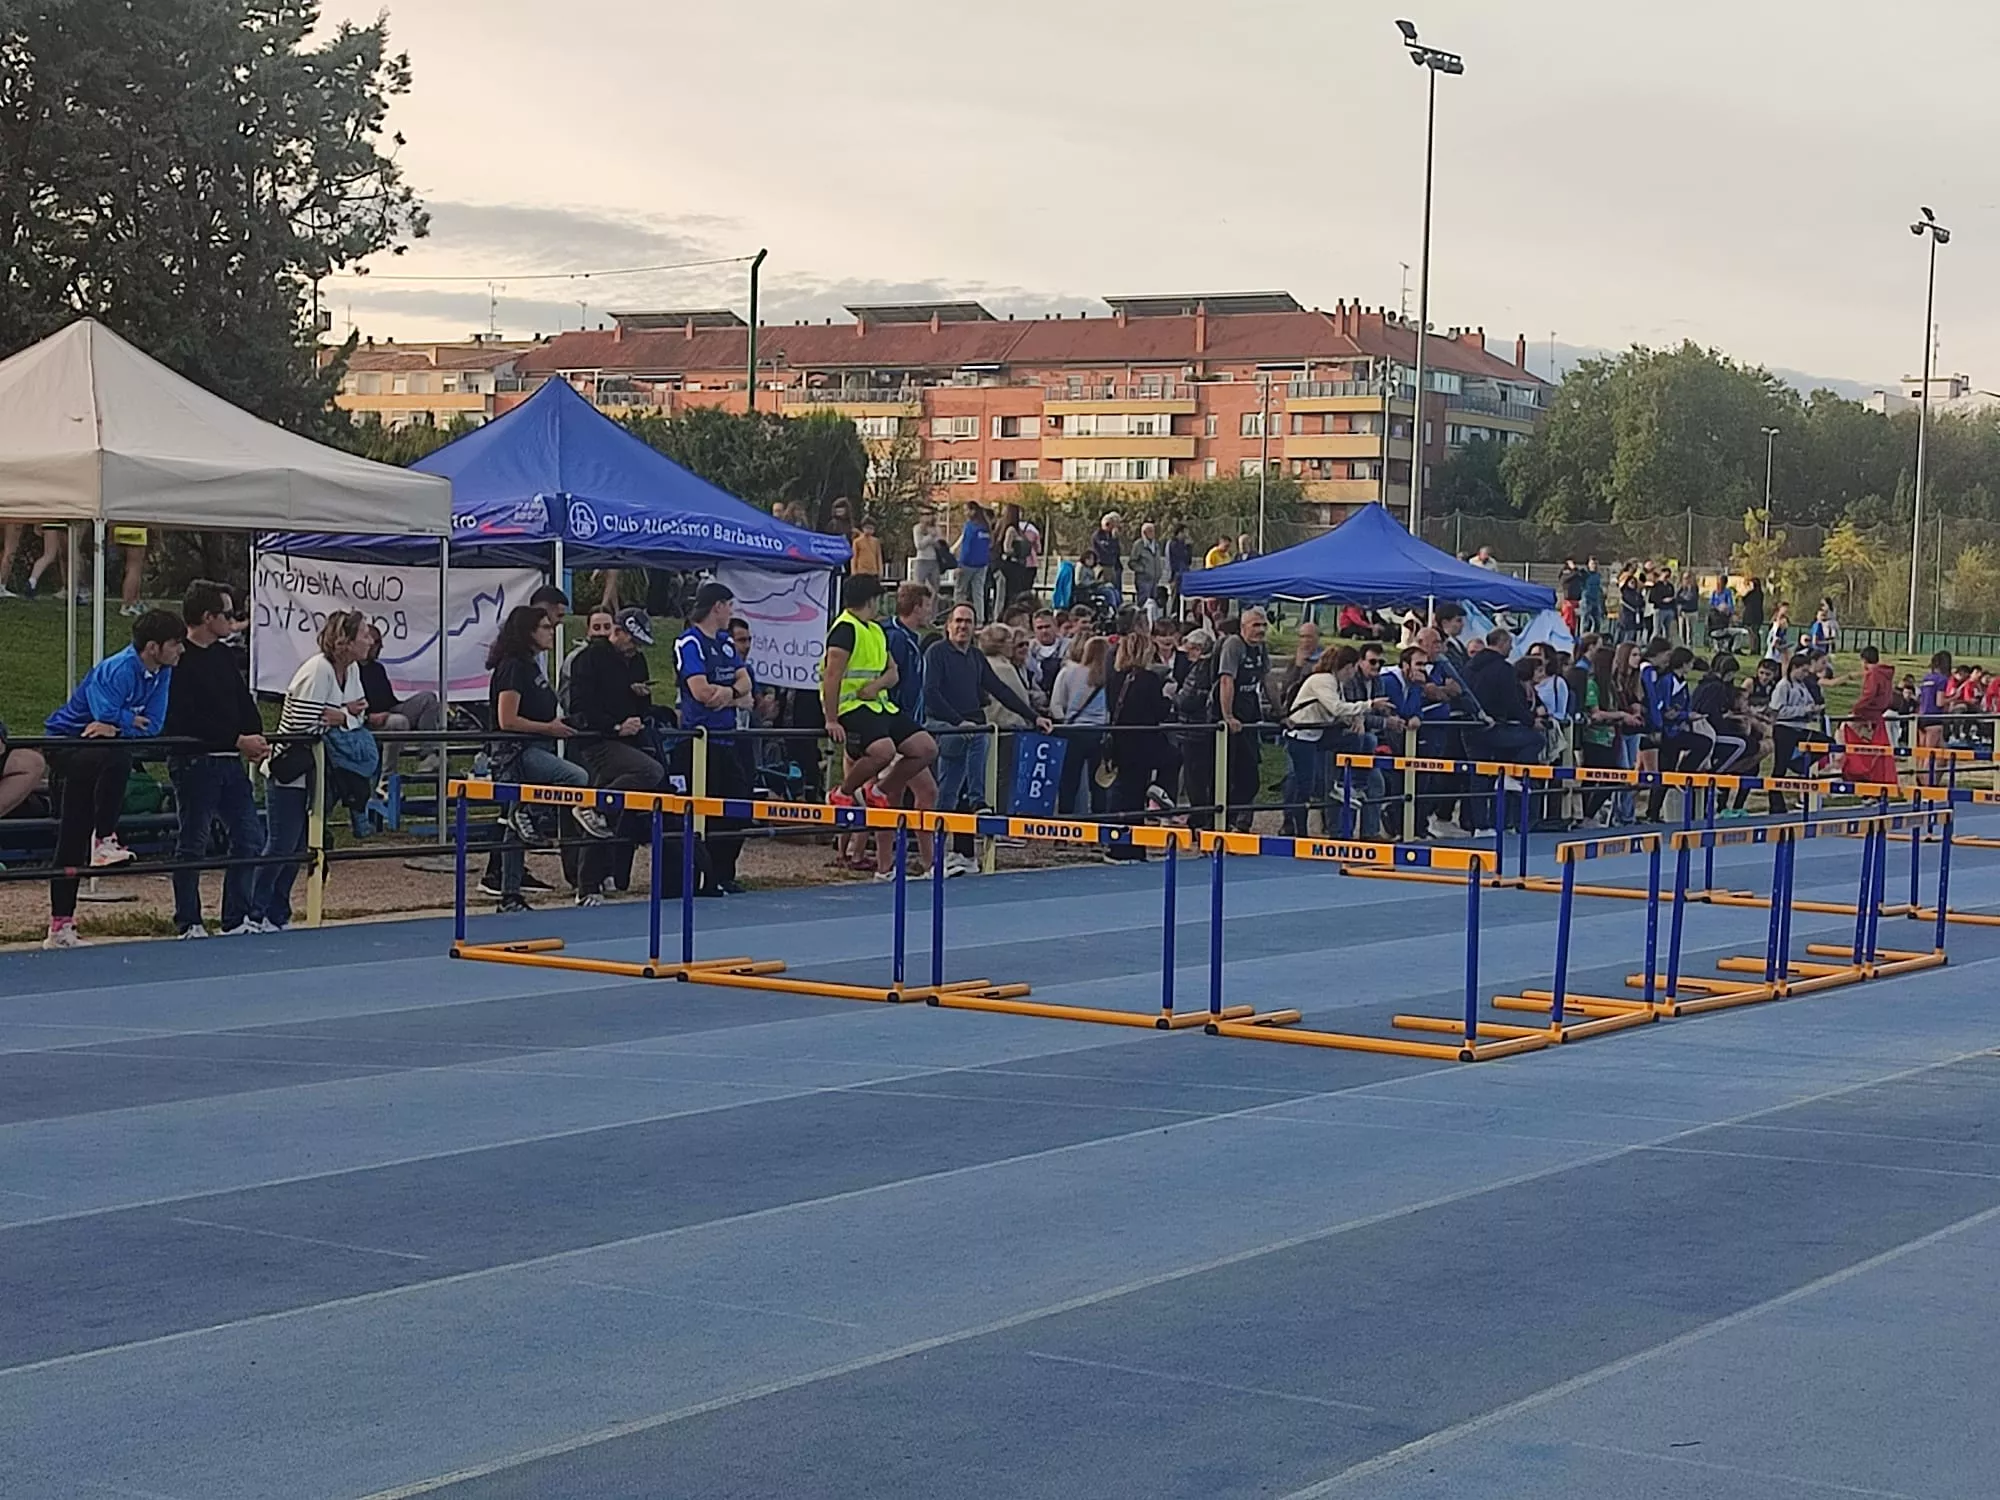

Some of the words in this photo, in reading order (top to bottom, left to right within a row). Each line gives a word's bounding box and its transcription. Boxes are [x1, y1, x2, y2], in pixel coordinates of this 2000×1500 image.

[603, 515, 639, 532] Club
[639, 518, 710, 537] Atletismo
[713, 523, 783, 551] Barbastro
[1029, 743, 1050, 798] CAB
[1405, 760, 1444, 769] MONDO
[1586, 770, 1628, 780] MONDO
[1775, 780, 1819, 791] MONDO
[533, 787, 584, 803] MONDO
[768, 805, 822, 820] MONDO
[1023, 823, 1083, 839] MONDO
[1311, 843, 1377, 861] MONDO
